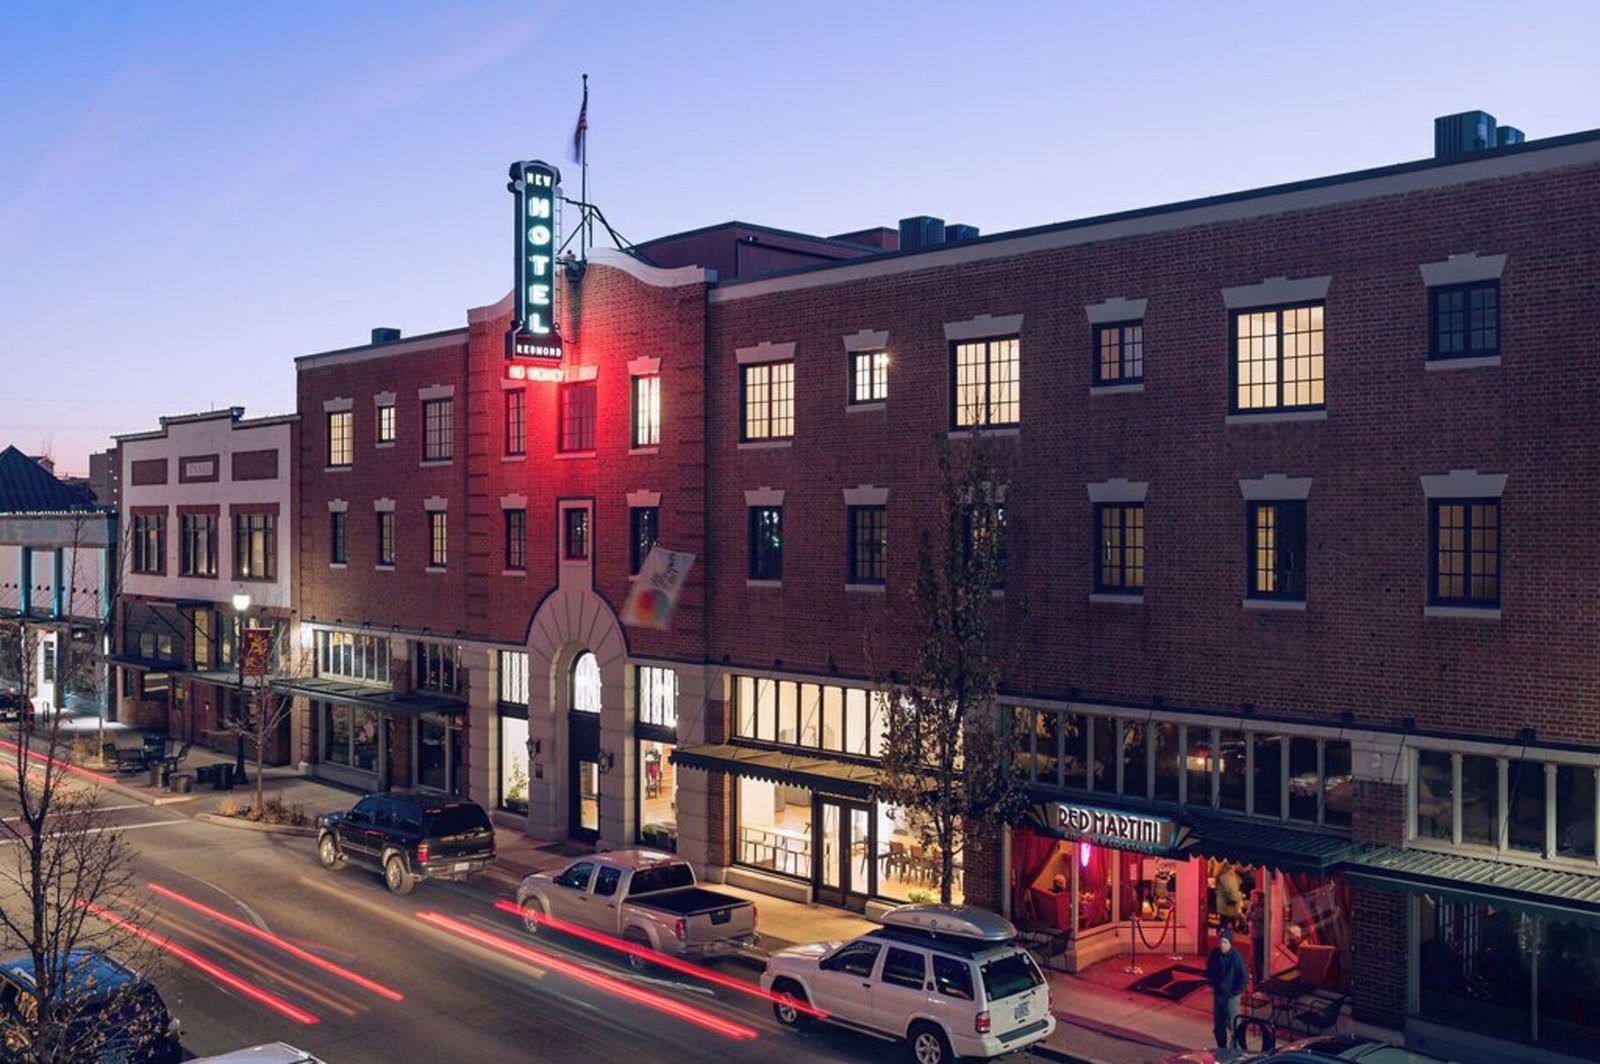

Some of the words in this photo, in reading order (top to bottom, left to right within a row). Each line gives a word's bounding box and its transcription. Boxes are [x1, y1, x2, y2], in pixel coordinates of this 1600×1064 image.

[526, 172, 552, 187] NEW
[528, 196, 551, 334] HOTEL
[516, 344, 562, 357] REDMOND
[1058, 804, 1092, 833] RED
[1093, 811, 1161, 843] MARTINI
